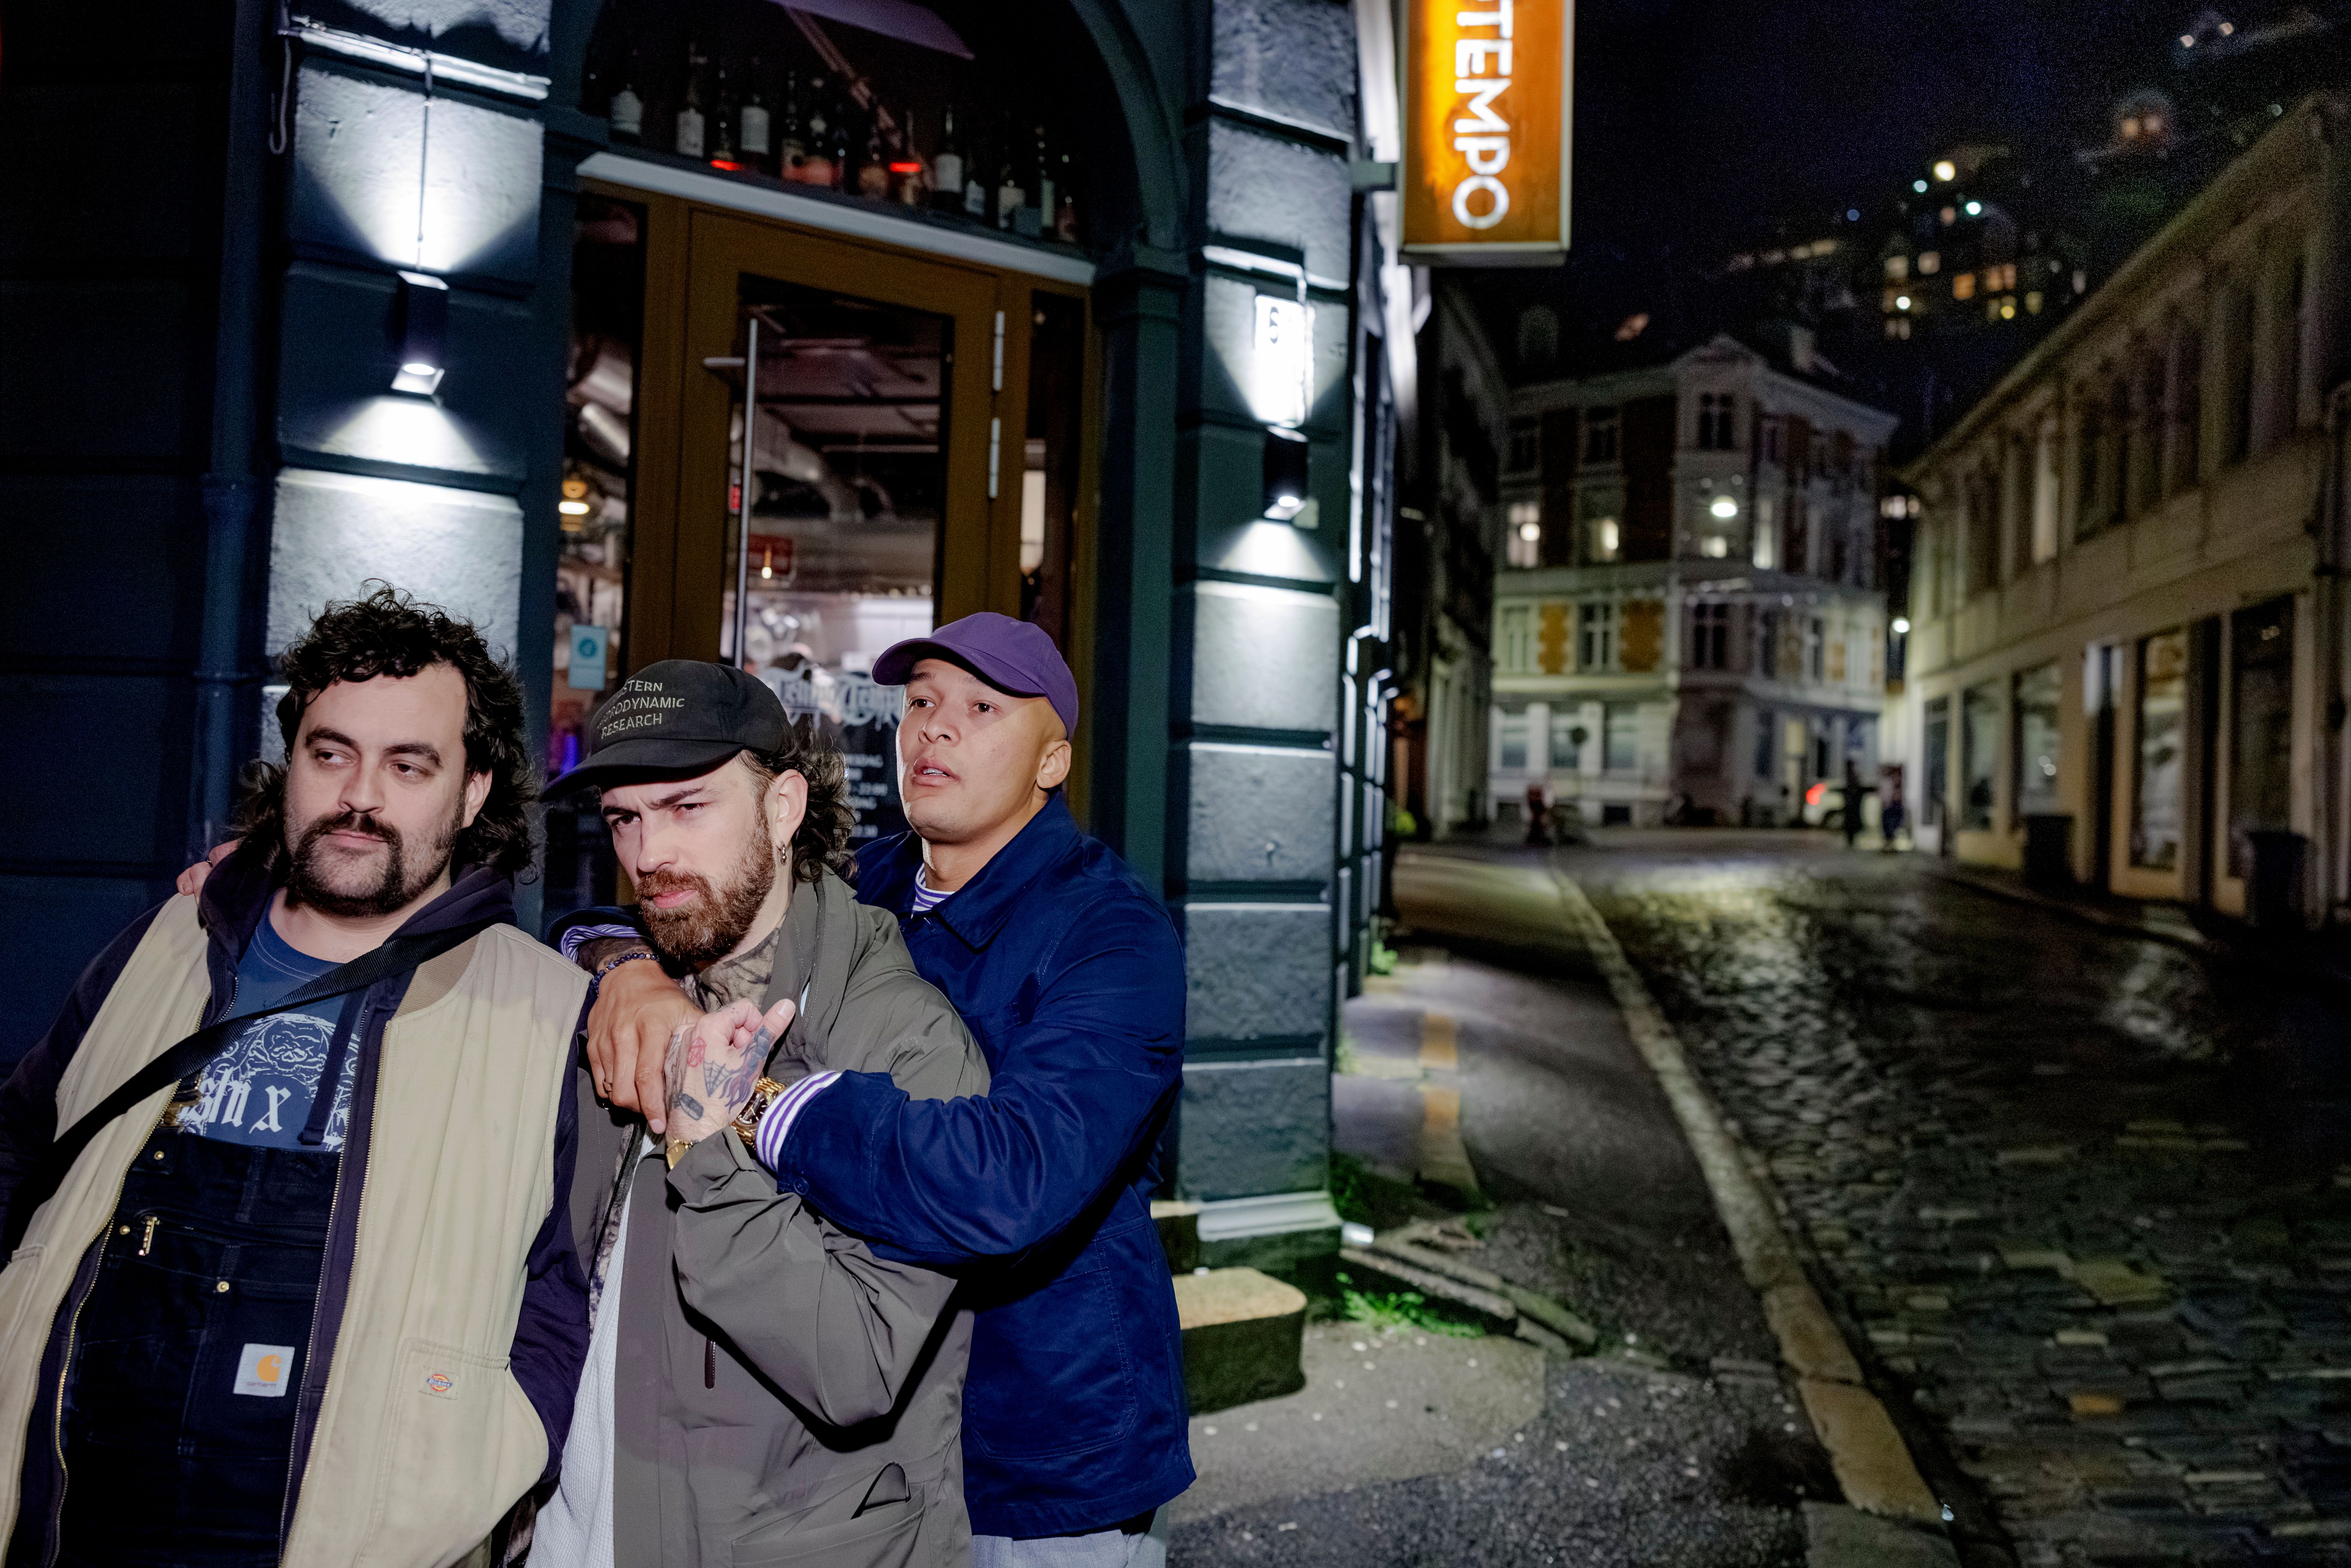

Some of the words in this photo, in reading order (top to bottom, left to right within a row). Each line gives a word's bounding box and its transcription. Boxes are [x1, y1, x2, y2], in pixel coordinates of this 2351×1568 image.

[1452, 0, 1514, 230] TEMPO
[623, 679, 663, 694] TERN
[601, 713, 662, 739] RESEARCH
